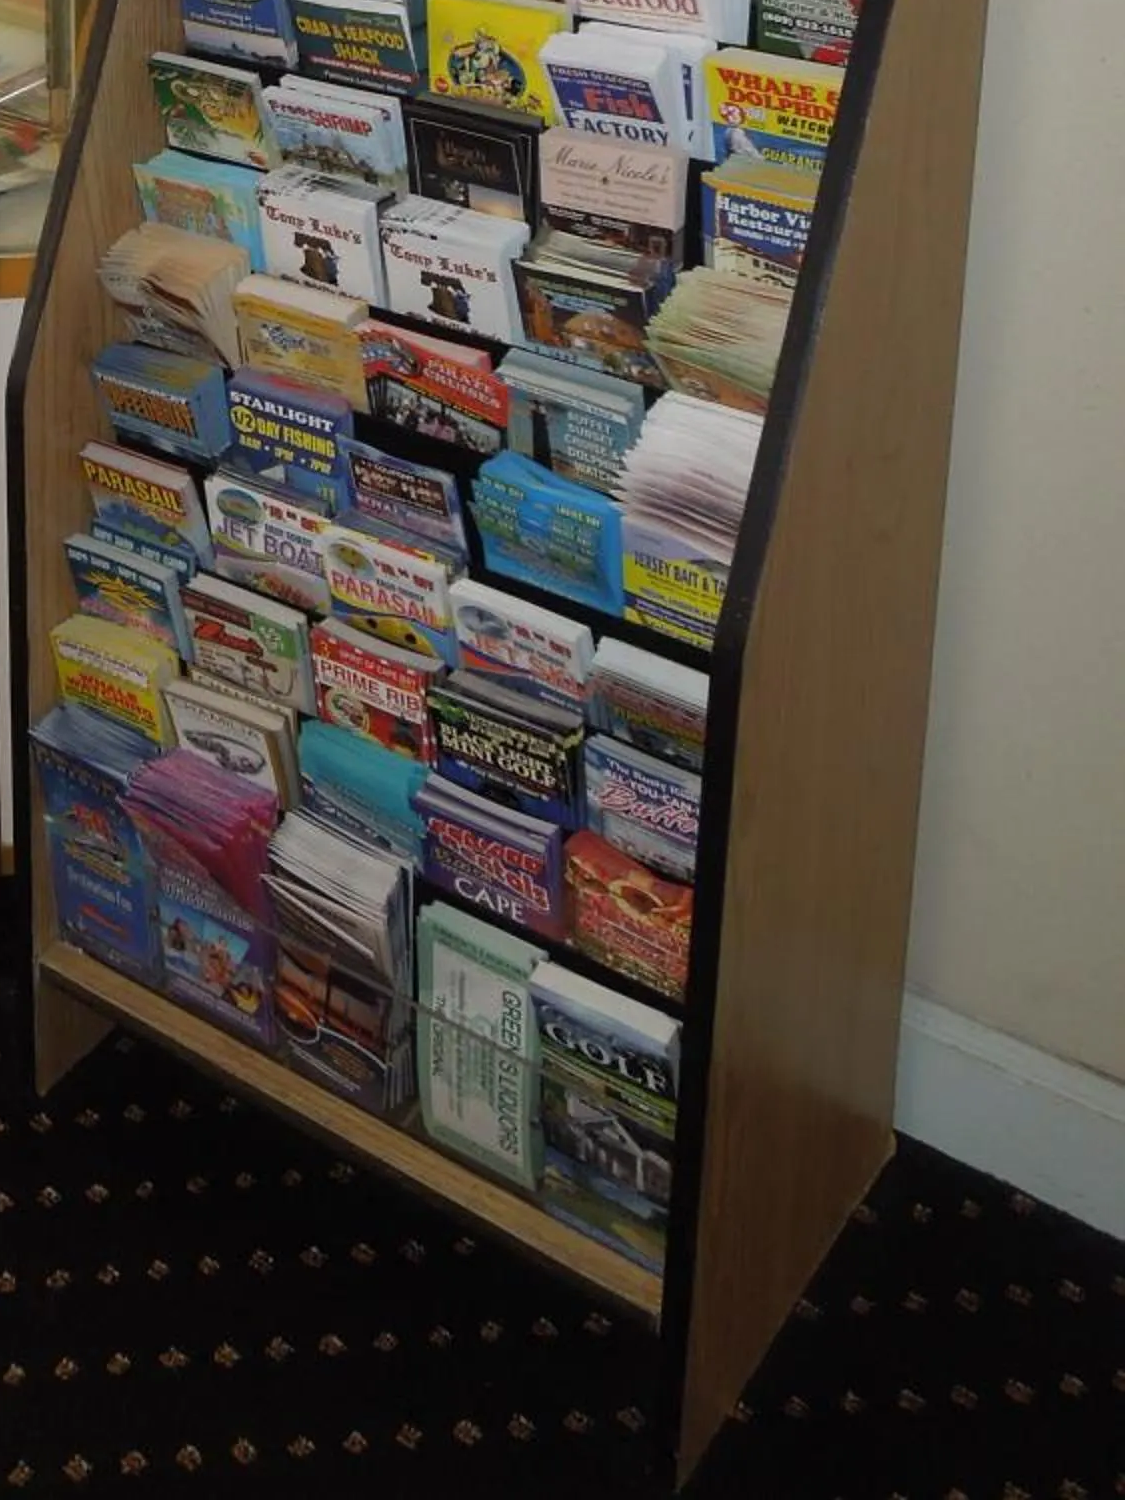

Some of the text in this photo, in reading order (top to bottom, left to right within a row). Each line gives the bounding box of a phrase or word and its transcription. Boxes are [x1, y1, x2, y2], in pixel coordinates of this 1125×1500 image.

[344, 26, 405, 51] SEAFOOD
[583, 87, 654, 122] Fish
[717, 67, 812, 102] WHALE
[563, 108, 669, 146] FACTORY
[265, 204, 362, 245] Tony Luke's
[716, 195, 780, 223] Harbor
[388, 242, 498, 283] Tony Luke's
[229, 390, 335, 433] STARLIGHT
[257, 417, 280, 440] DAY
[282, 424, 336, 459] FISHING
[83, 461, 184, 516] PARASAIL
[216, 517, 324, 575] JET BOAT
[634, 550, 672, 577] JERSEY
[674, 565, 699, 588] BAIT
[331, 569, 448, 628] PARASAIL
[320, 659, 380, 695] PRIME
[386, 688, 421, 711] RIB
[497, 756, 557, 788] GOLF
[453, 876, 528, 925] CAPE
[544, 1022, 669, 1093] GOLF
